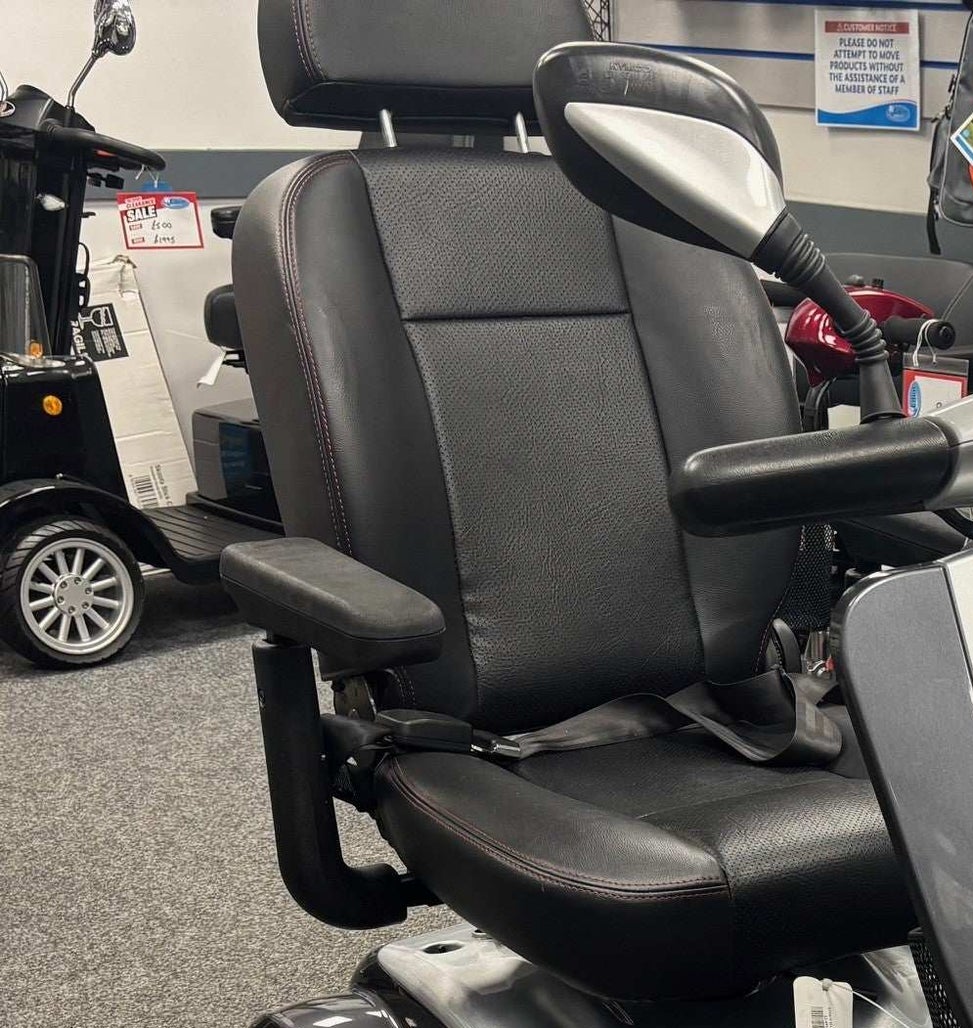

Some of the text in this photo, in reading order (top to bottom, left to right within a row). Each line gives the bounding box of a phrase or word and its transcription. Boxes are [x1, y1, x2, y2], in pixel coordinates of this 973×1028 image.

[843, 23, 897, 32] CUSTOMER NOTICE
[839, 37, 894, 48] PLEASE DO NOT
[833, 49, 900, 60] ATTEMPT TO MOVE
[829, 61, 904, 72] PRODUCTS WITHOUT
[829, 72, 906, 85] THE ASSISTANCE OF A
[835, 84, 899, 96] MEMBER OF STAFF
[126, 205, 157, 222] SALE
